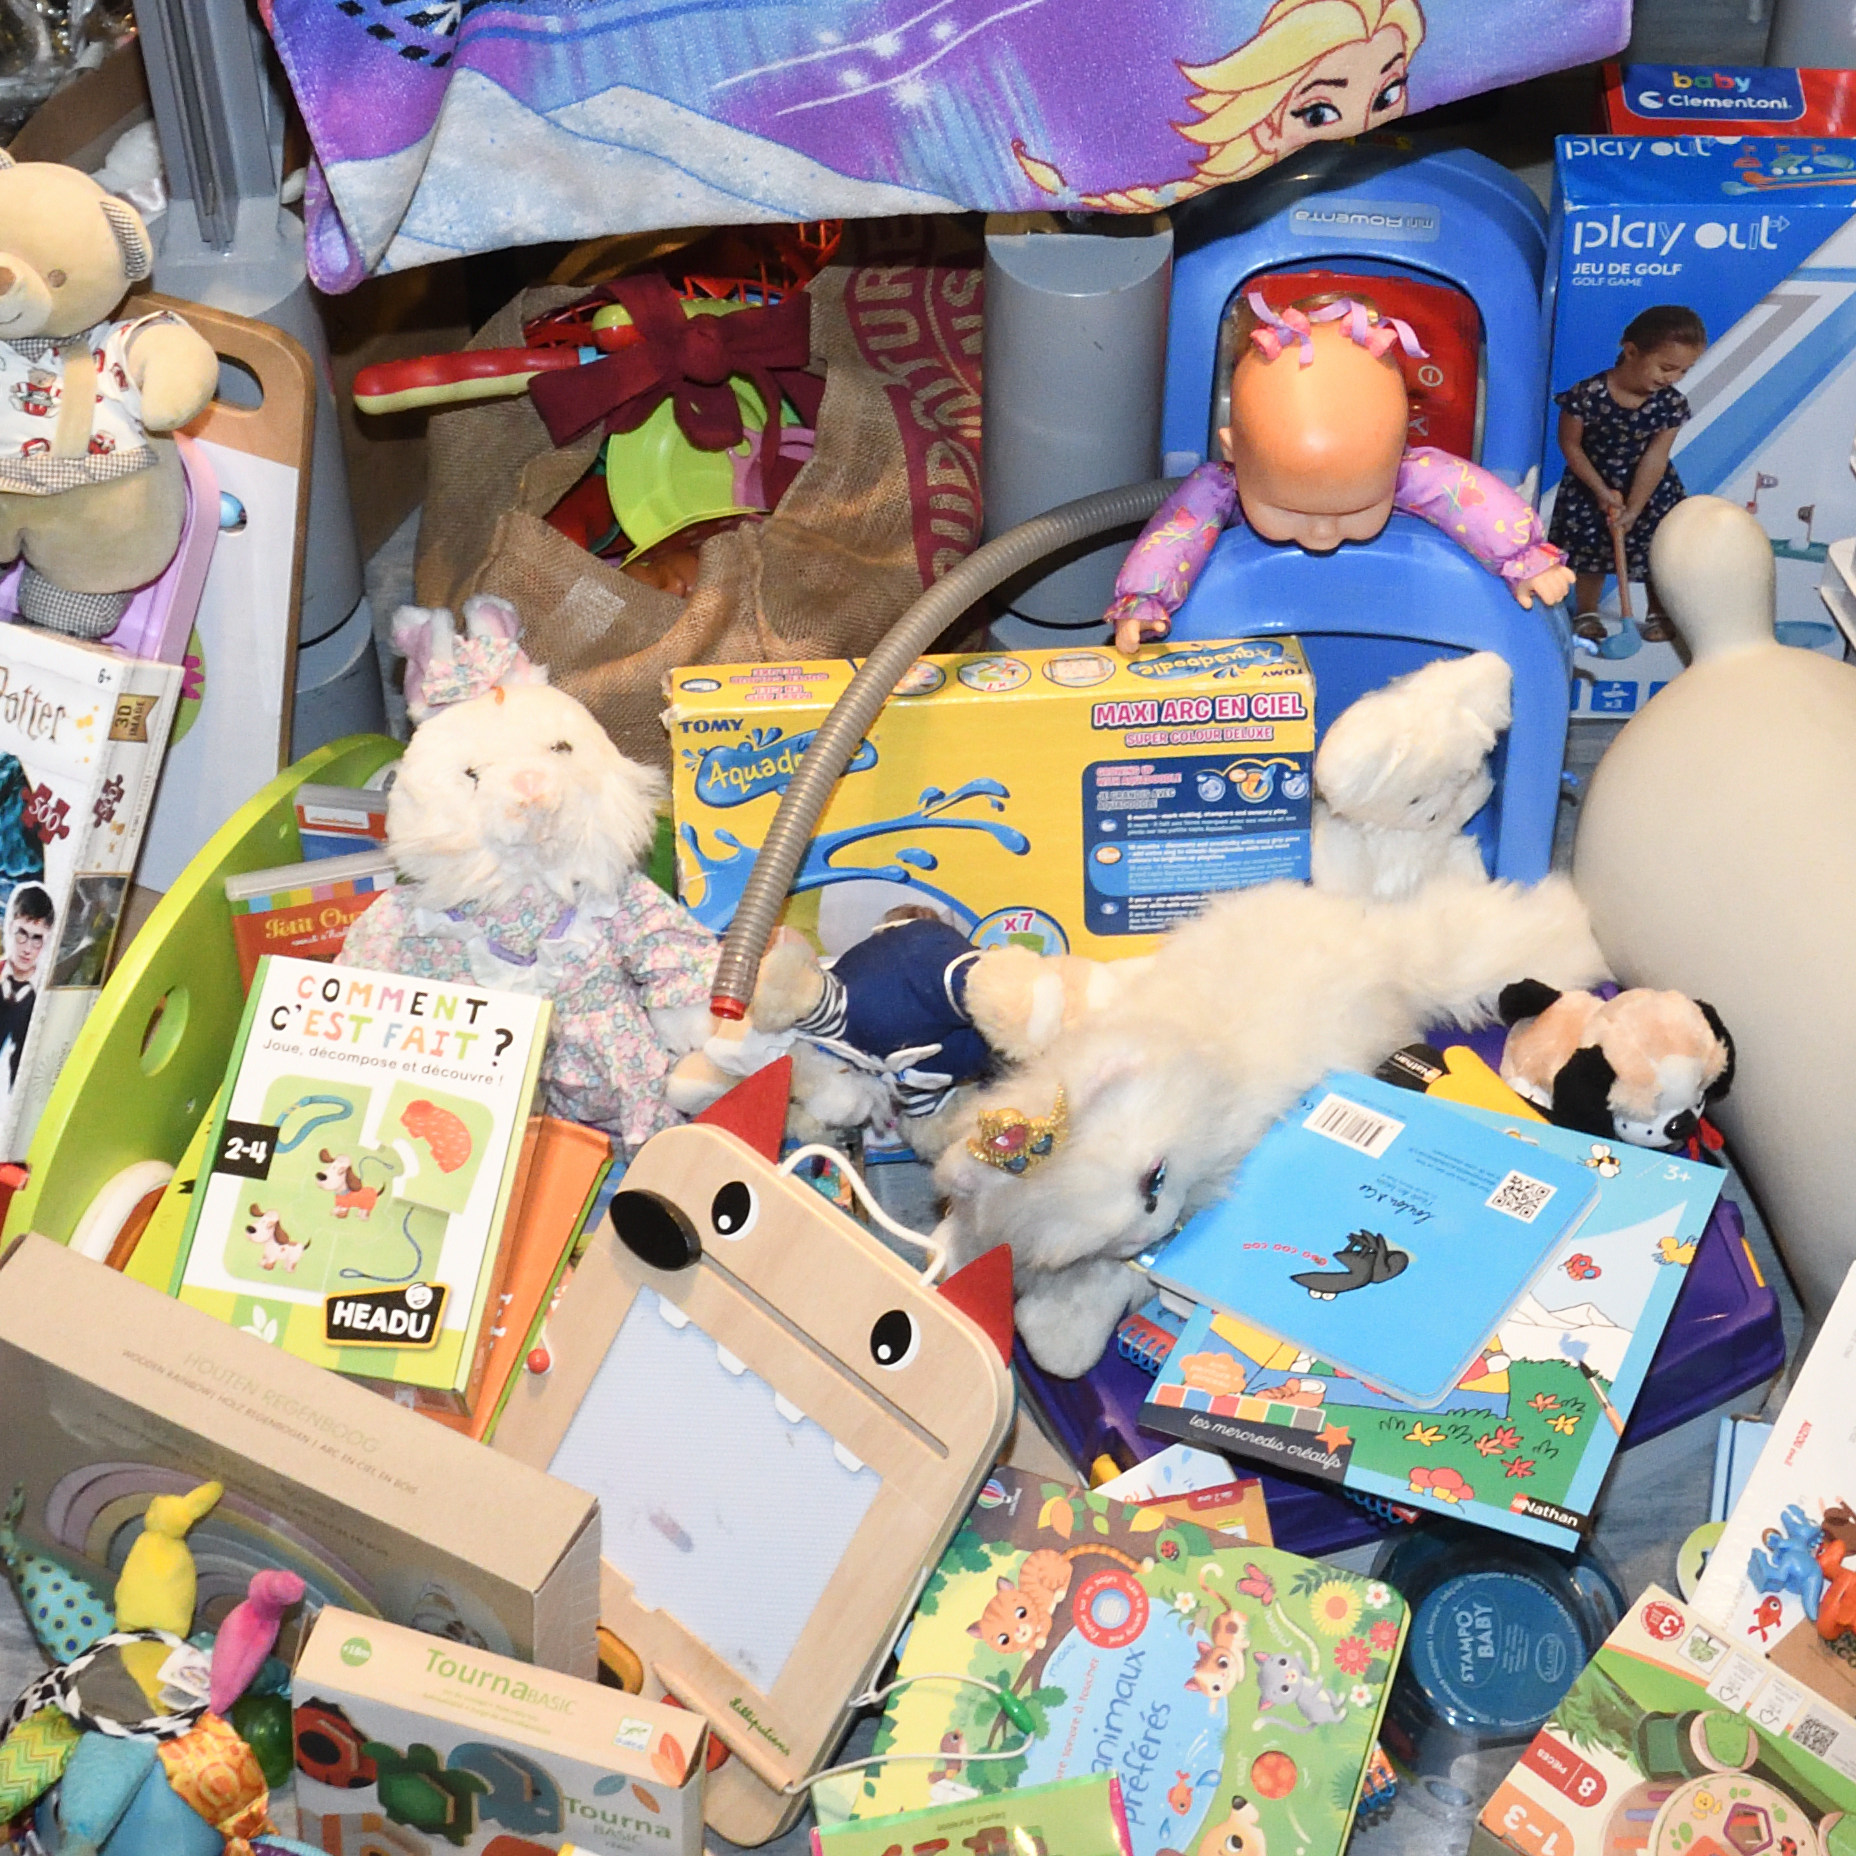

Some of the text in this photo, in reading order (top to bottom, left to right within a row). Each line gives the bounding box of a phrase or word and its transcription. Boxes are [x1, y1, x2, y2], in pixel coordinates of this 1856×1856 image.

[1671, 70, 1751, 95] baby
[1666, 92, 1789, 111] Clementoni
[1573, 215, 1687, 254] play
[1572, 262, 1683, 277] JEU DE GOLF
[1572, 277, 1643, 288] GOLF GAME
[97, 666, 113, 684] 6+
[678, 718, 744, 734] TOMY
[1094, 692, 1307, 728] MAXI ARC EN CIEL
[1124, 726, 1274, 747] SUPER COLOUR DELUXE
[28, 795, 62, 832] 500
[1001, 913, 1035, 933] x7
[296, 974, 489, 1026] COMMENT
[270, 1002, 515, 1067] C'EST FAIT ?
[262, 1038, 495, 1086] Joue, décompose et découvre
[1391, 1052, 1433, 1079] Nathan
[224, 1138, 269, 1164] 2-4
[1662, 1165, 1693, 1183] 3+
[331, 1300, 432, 1342] HEADU
[183, 1351, 380, 1454] HOUTEN REGENBOOG
[1211, 1422, 1343, 1471] mercredis créatifs
[1525, 1497, 1579, 1527] Nathan
[1455, 1607, 1476, 1685] STAMPO
[1472, 1601, 1495, 1660] BABY
[1091, 1647, 1147, 1776] animaux
[1124, 1699, 1173, 1827] préférés
[1576, 1775, 1598, 1797] 8
[562, 1797, 673, 1841] Tourna
[592, 1824, 642, 1844] BASIC
